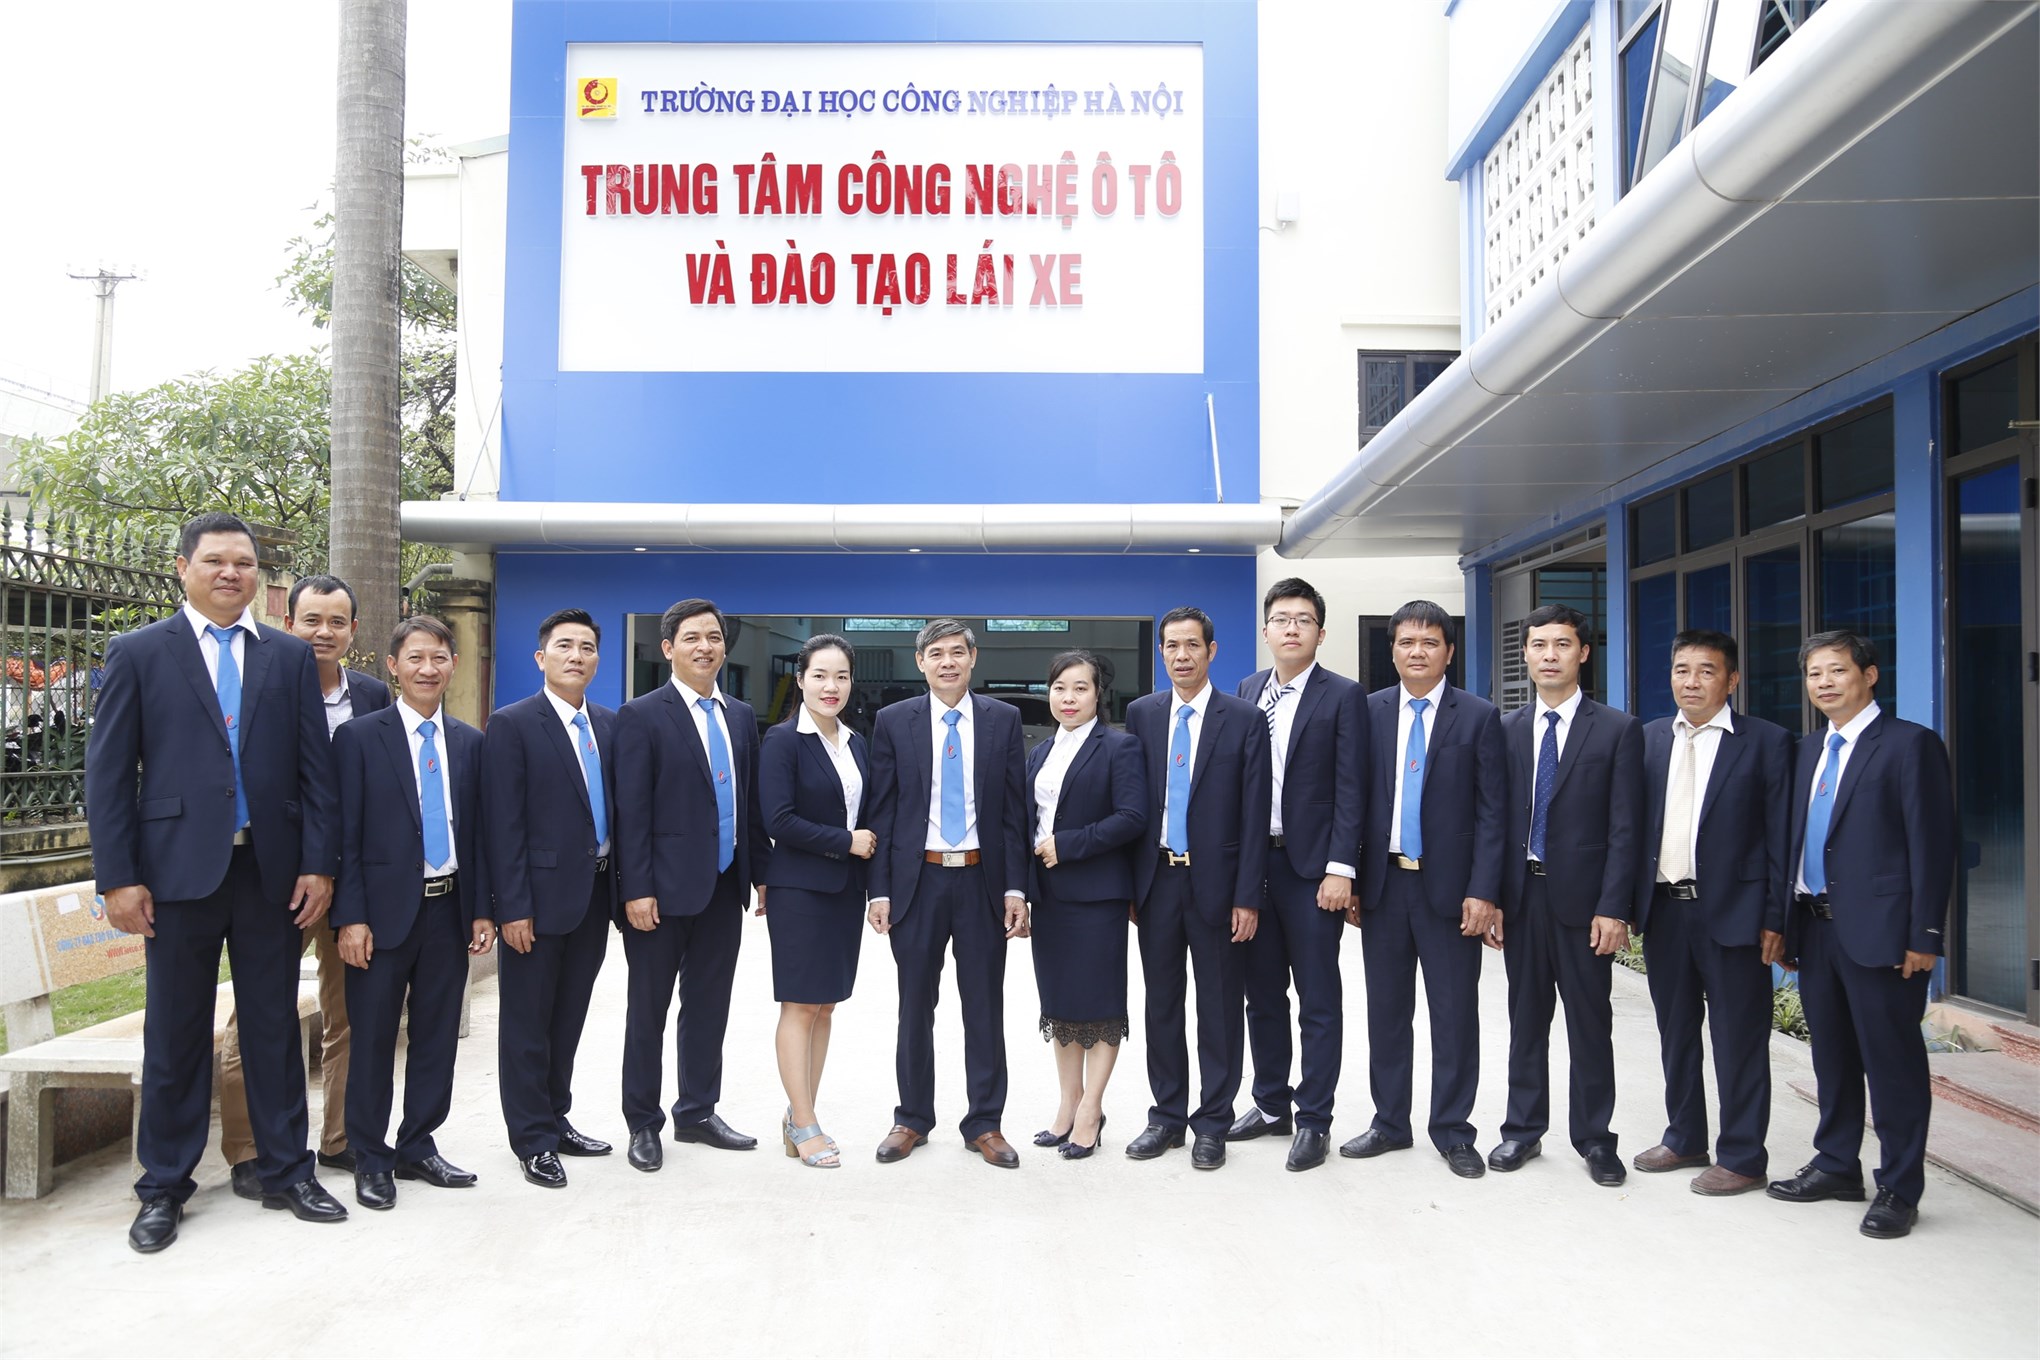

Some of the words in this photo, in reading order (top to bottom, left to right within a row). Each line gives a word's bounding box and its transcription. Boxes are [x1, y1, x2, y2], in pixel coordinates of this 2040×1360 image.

[641, 81, 755, 113] TRƯỜNG
[761, 90, 812, 117] ĐẠI
[818, 89, 876, 118] HỌC
[883, 82, 962, 113] CÔNG
[967, 83, 1078, 119] NGHIỆP
[1084, 82, 1126, 114] HÀ
[1131, 82, 1184, 119] NỘI
[581, 162, 718, 216] TRUNG
[733, 151, 823, 216] TÂM
[837, 150, 951, 216] CÔNG
[965, 150, 1079, 228] NGHỆ
[1092, 151, 1118, 216] Ô
[1129, 150, 1182, 216] TÔ
[685, 239, 736, 306] VÀ
[750, 239, 836, 306] ĐÀO
[851, 252, 931, 316] TẠO
[945, 239, 1015, 306] LÁI
[1029, 253, 1083, 306] XE
